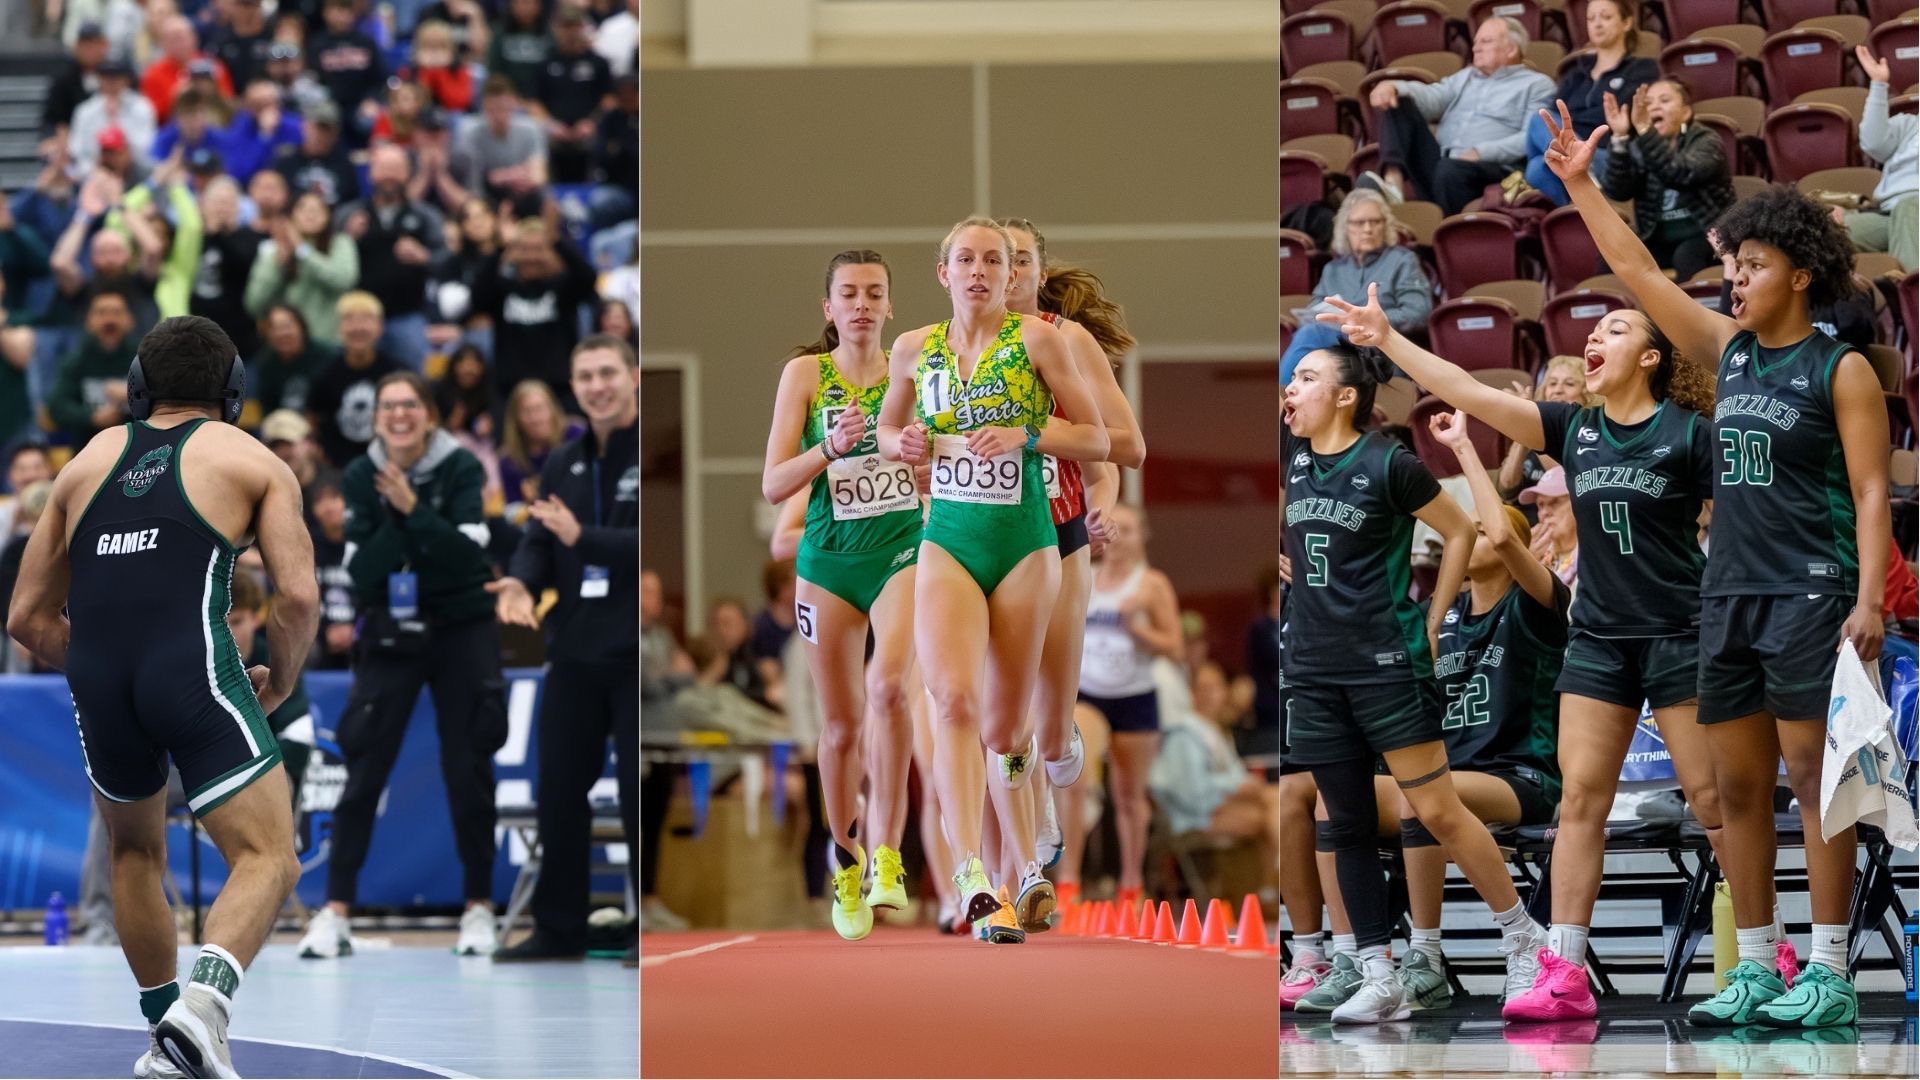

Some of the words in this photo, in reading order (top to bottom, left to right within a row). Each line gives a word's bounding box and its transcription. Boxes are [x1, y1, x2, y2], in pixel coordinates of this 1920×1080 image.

[824, 389, 847, 397] RMAC
[928, 373, 941, 412] 1
[955, 401, 1024, 431] State
[1714, 394, 1800, 431] GRIZZLIES
[118, 462, 169, 483] ADAMS
[935, 455, 1020, 490] 5039
[1719, 428, 1774, 486] 30
[128, 477, 153, 488] STATE
[835, 468, 914, 507] 5028
[938, 488, 957, 496] RMAC
[958, 490, 1013, 500] CHAMPIONSHIP
[1574, 466, 1668, 499] GRIZZLIES
[842, 507, 862, 515] RMAC
[863, 498, 911, 514] CHAMPIONSHIP
[1285, 498, 1367, 532] GRIZZLIES
[96, 527, 159, 556] GAMEZ
[1600, 501, 1634, 555] 4
[1305, 533, 1329, 586] 5
[797, 602, 813, 638] 5
[1434, 643, 1505, 680] GRIZZES
[1441, 673, 1490, 731] 22
[1838, 765, 1859, 786] RADE
[1880, 779, 1910, 802] WERAD
[1905, 935, 1914, 990] POWERADE
